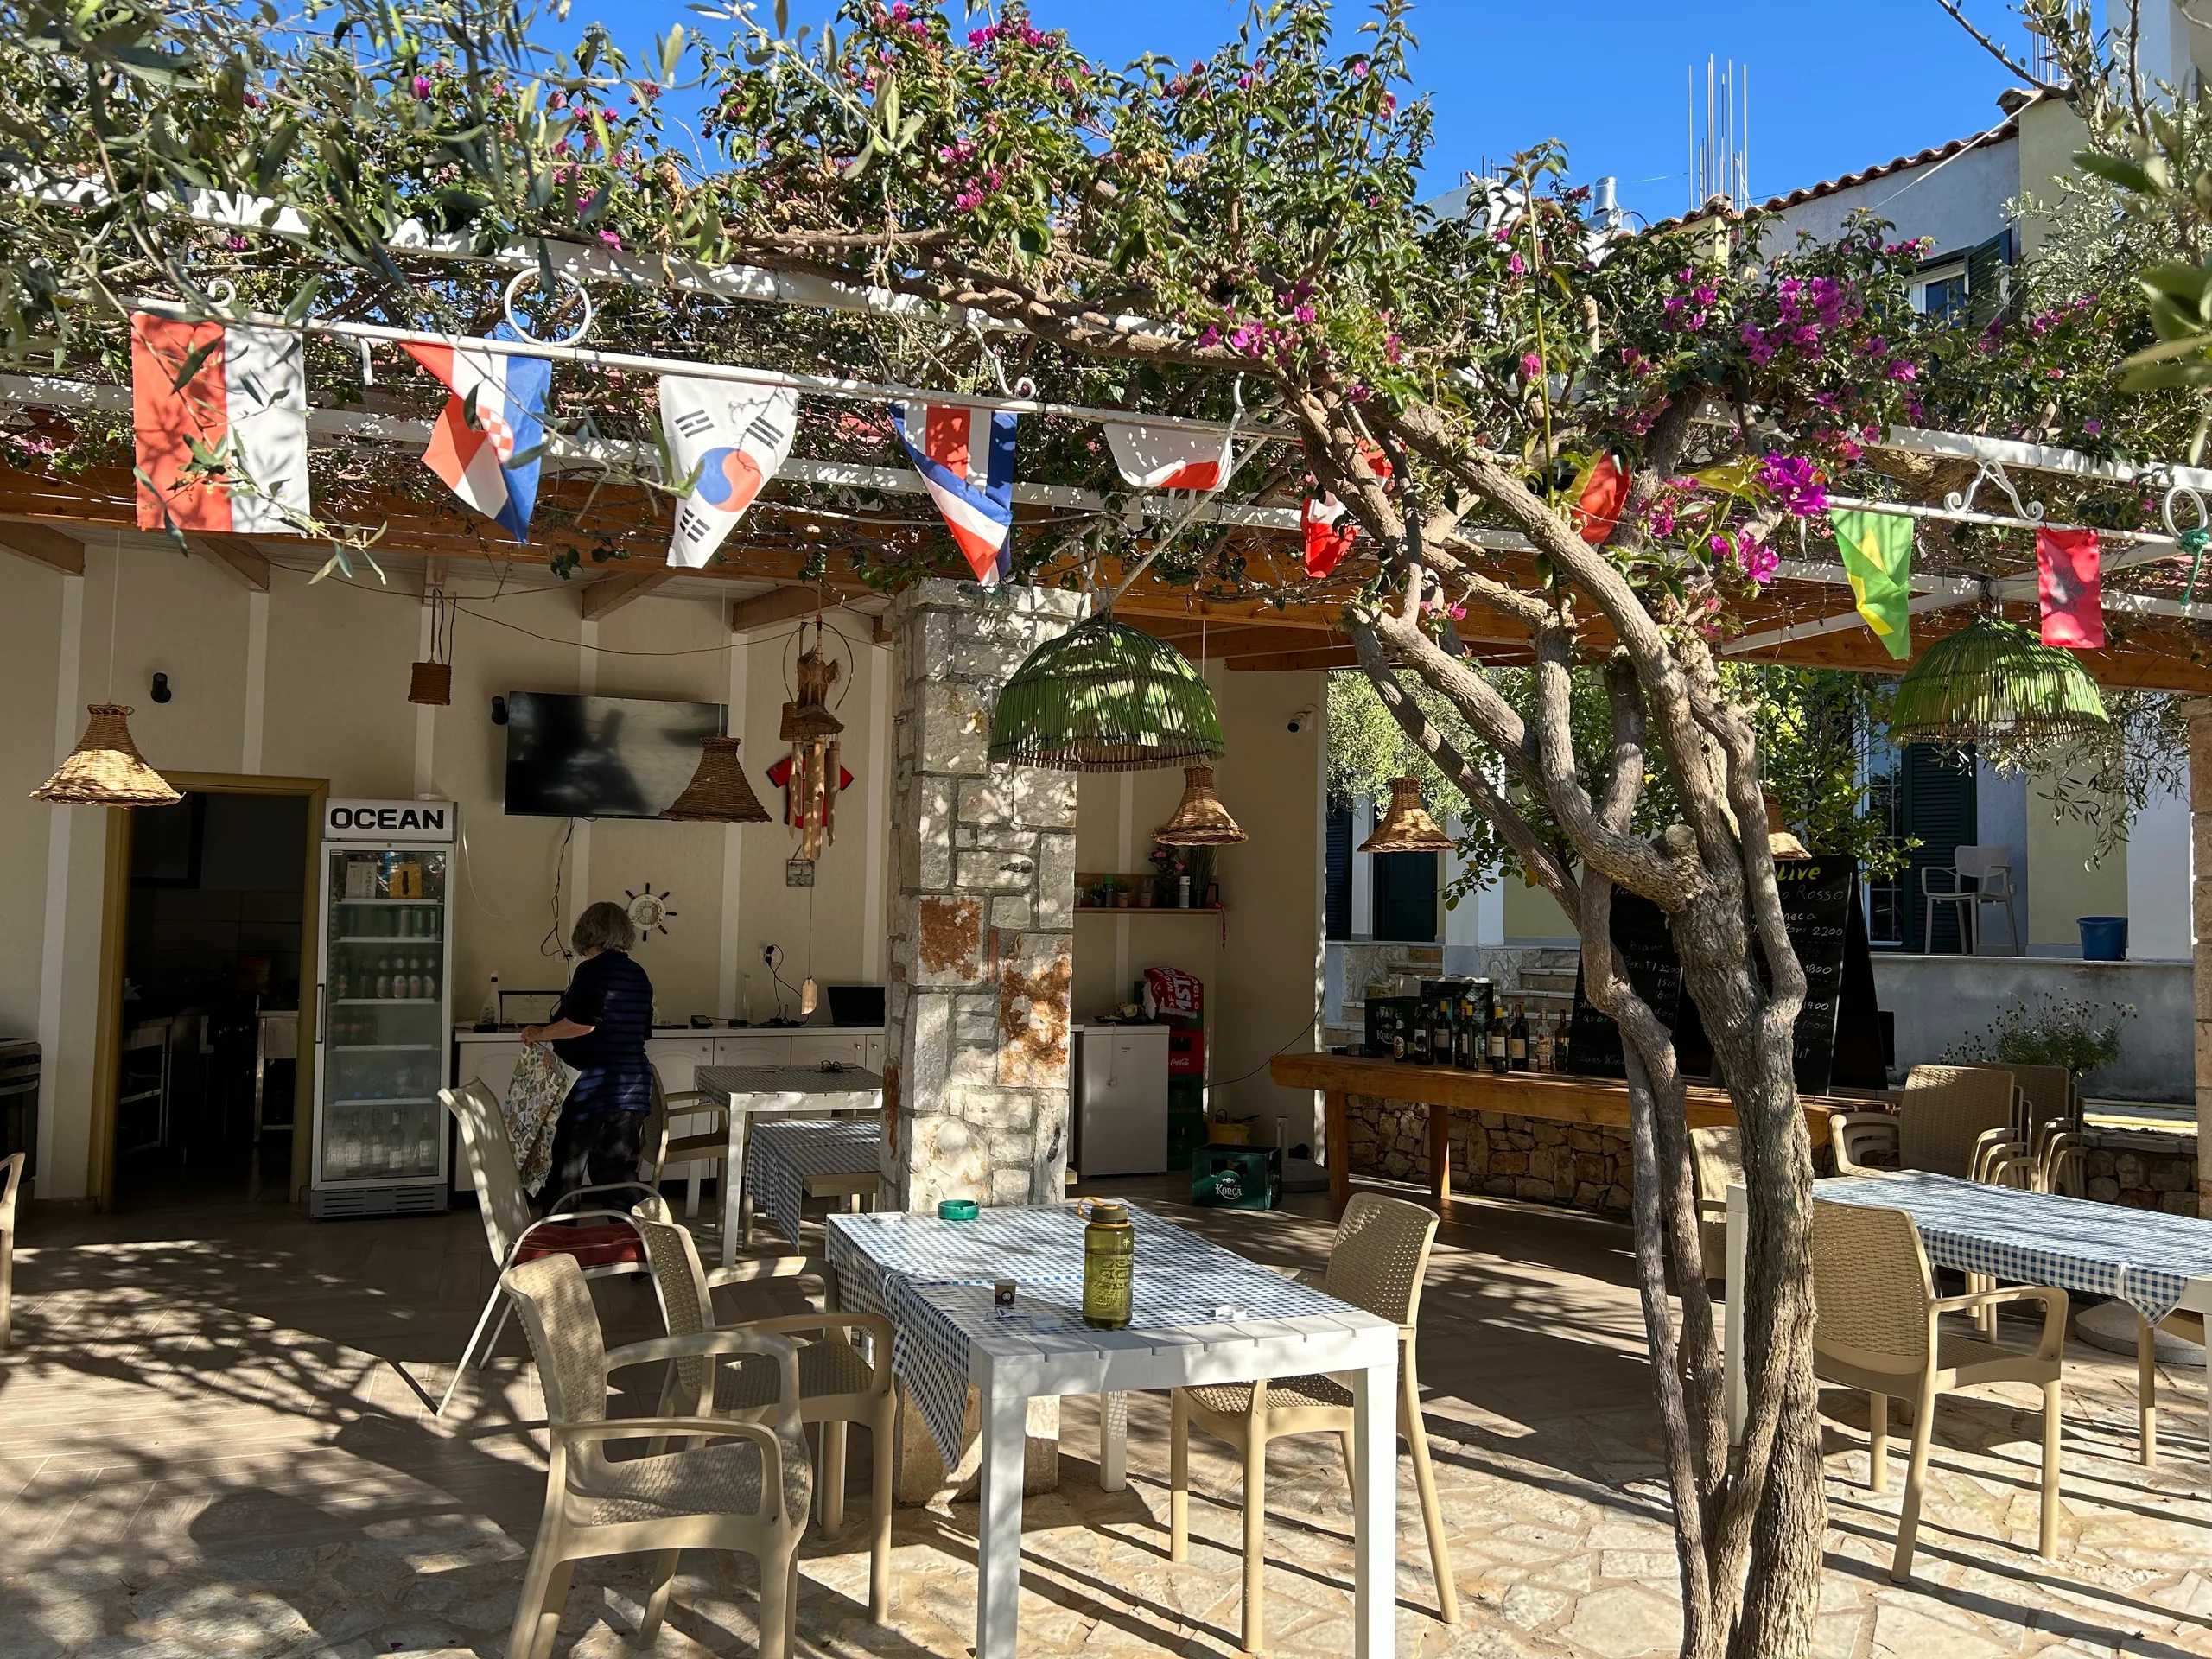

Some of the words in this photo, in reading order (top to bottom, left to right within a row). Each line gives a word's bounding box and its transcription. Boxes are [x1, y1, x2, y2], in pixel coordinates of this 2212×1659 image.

[330, 808, 444, 830] OCEAN
[1777, 861, 1821, 881] Live
[1796, 884, 1844, 901] Rosso
[1812, 926, 1843, 937] 2200
[1805, 963, 1833, 975] 1800
[1803, 1001, 1829, 1011] 1400
[1802, 1020, 1827, 1030] 1000
